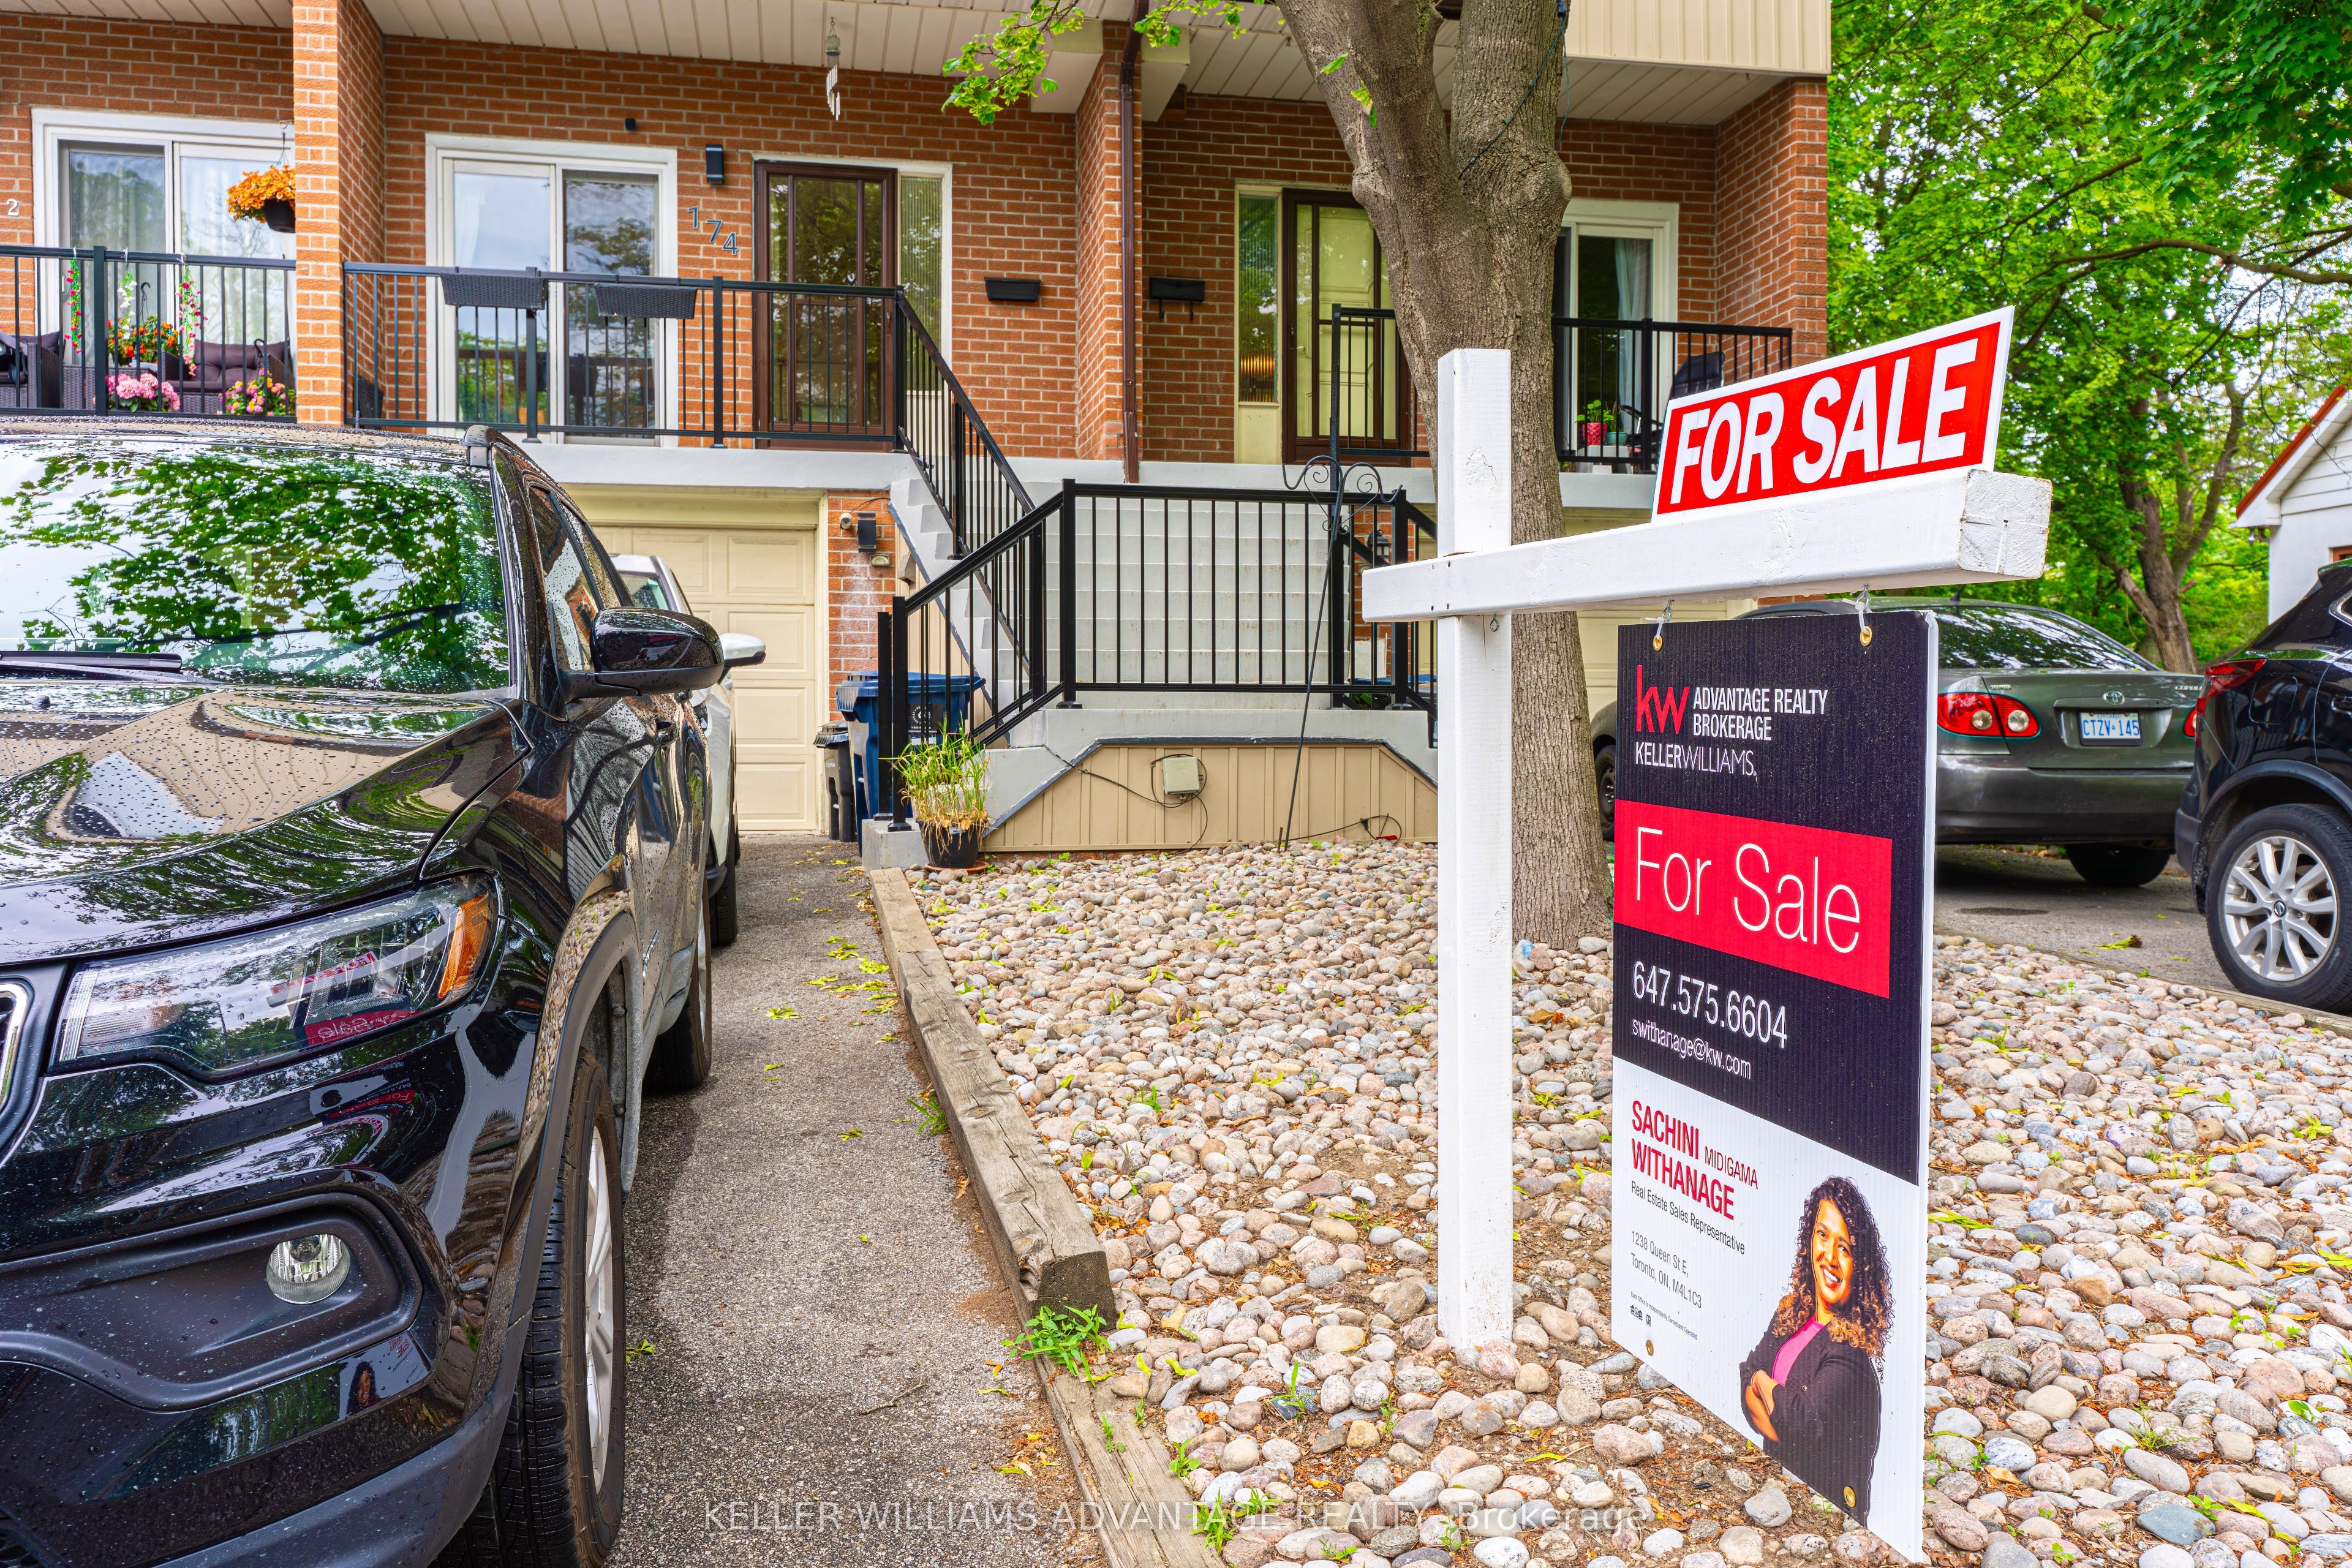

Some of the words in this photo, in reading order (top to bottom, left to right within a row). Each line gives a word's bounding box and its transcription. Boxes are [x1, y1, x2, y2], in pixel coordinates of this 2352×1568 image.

[6, 198, 19, 216] 2
[687, 206, 739, 255] 174
[1670, 392, 1784, 505] FOR
[1793, 337, 1978, 484] SALE
[1635, 665, 1690, 734] kw
[1693, 687, 1770, 713] ADVANTAGE
[1774, 688, 1828, 715] REALTY
[1694, 713, 1772, 741] BROKERAGE
[1637, 826, 1712, 916] For
[1733, 843, 1860, 954] Sale
[1633, 961, 1787, 1049] 647.575.6604
[1632, 1019, 1751, 1079] swithanage@kw.com
[1632, 1100, 1699, 1159] SACHINI
[1705, 1145, 1758, 1189] MIDIGAMA
[1631, 1137, 1734, 1221] WITHANAGE
[1632, 1180, 1645, 1199] Real
[1648, 1189, 1668, 1212] Estate
[1670, 1201, 1688, 1223] Sales
[1691, 1212, 1745, 1254] Representative
[1631, 1253, 1657, 1283] Toronto,
[1659, 1270, 1670, 1291] ON,
[1673, 1278, 1702, 1308] M4L1C3
[1632, 1231, 1648, 1250] 1238
[1650, 1241, 1671, 1265] Queen
[1673, 1254, 1680, 1271] St
